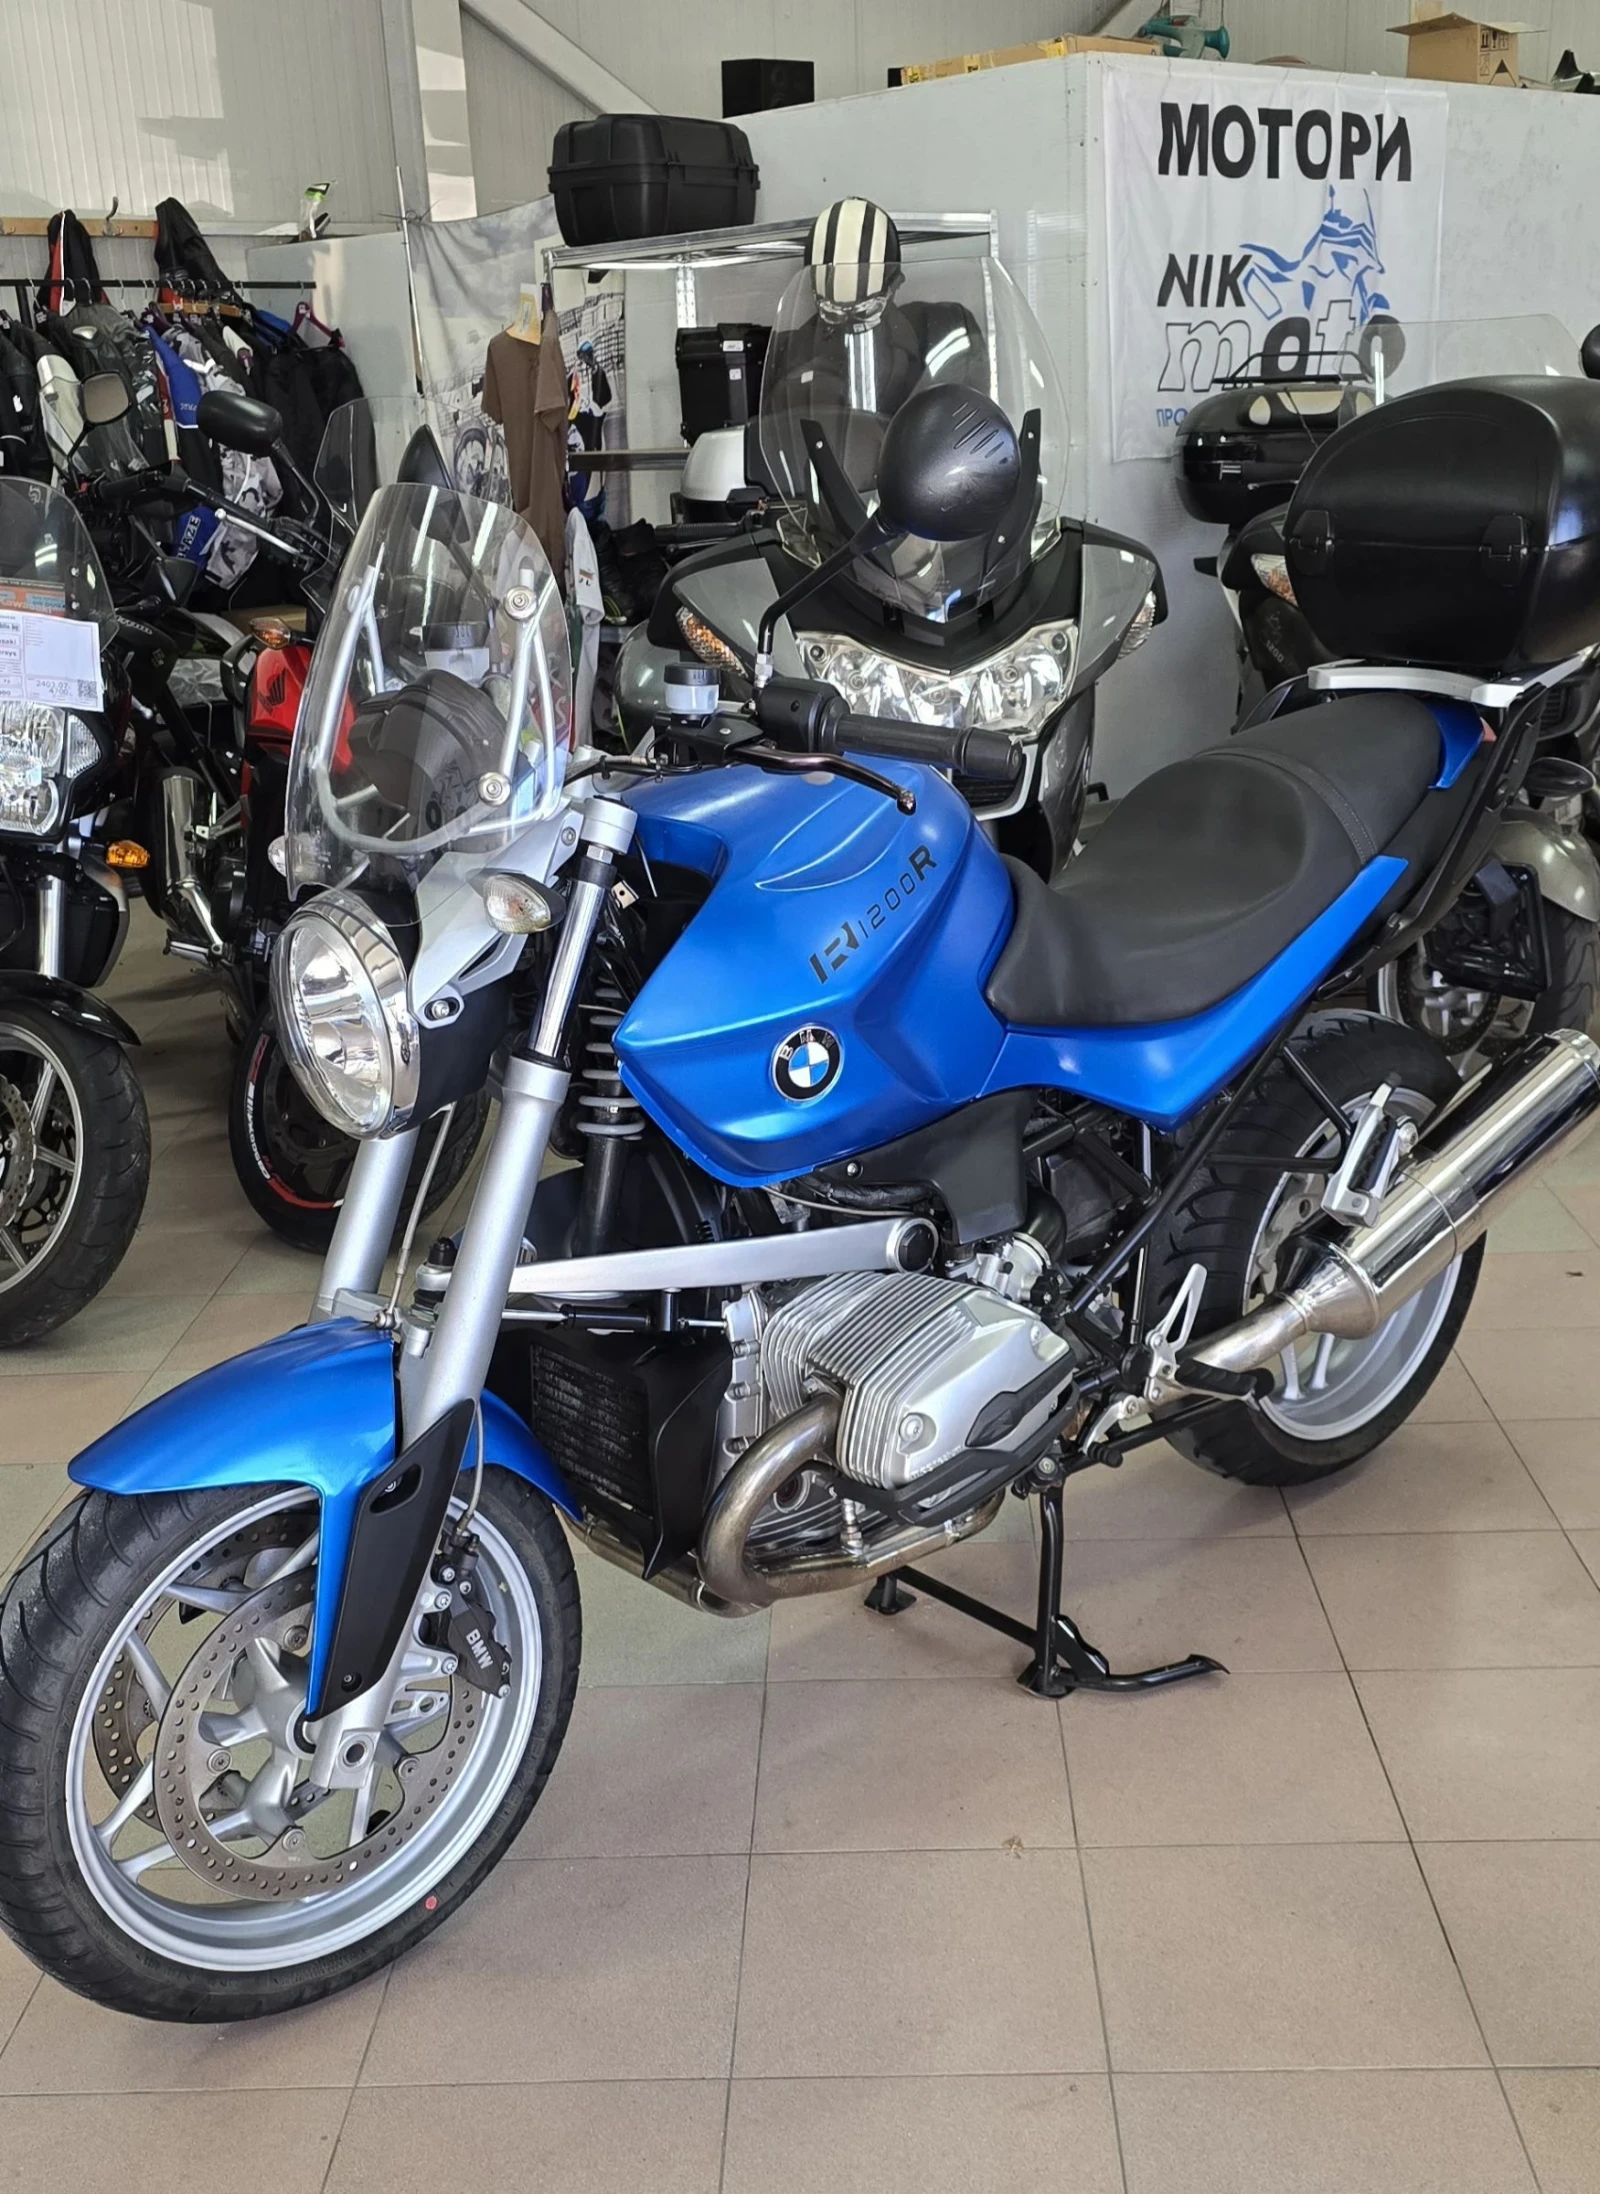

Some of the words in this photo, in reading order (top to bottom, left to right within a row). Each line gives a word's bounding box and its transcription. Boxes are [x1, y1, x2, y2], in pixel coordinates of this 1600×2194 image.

[1158, 101, 1412, 182] МОТОРИ
[1157, 253, 1252, 308] NIK
[465, 1628, 494, 1670] BMW
